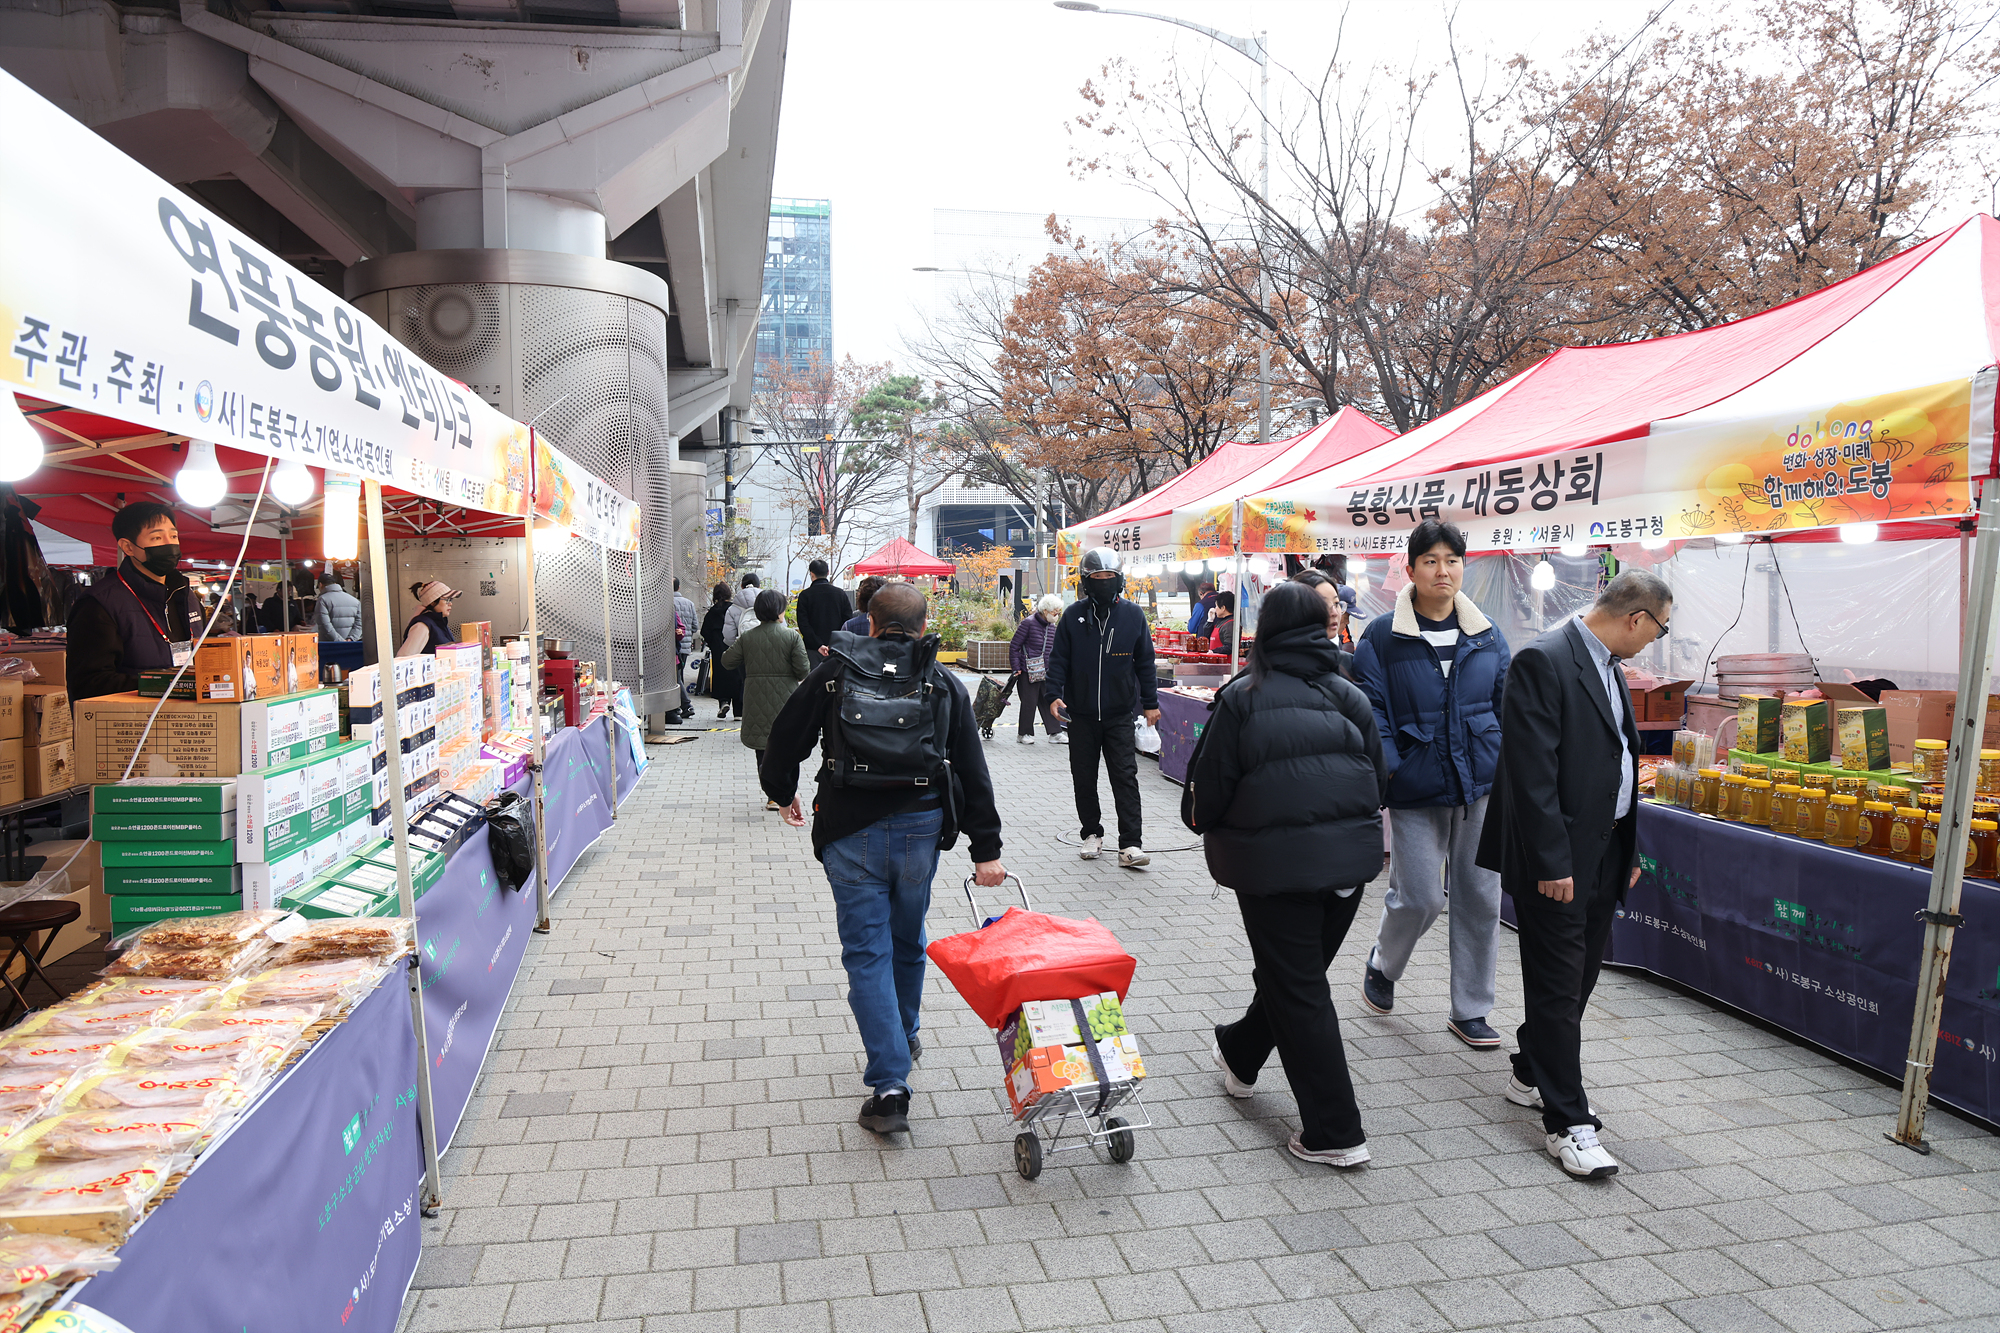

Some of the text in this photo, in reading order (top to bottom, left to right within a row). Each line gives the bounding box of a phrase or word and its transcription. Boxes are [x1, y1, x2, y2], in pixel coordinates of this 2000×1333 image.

[1788, 420, 1873, 448] dobong
[1783, 440, 1871, 472] 변화·성장·미래
[1491, 528, 1513, 546] 후원
[1538, 523, 1574, 543] 서울시
[1606, 515, 1664, 538] 도봉구청
[1645, 915, 1670, 931] 도봉구
[1776, 900, 1804, 918] 함께
[1791, 972, 1821, 992] 도봉구
[1824, 985, 1879, 1015] 소상공인회
[1938, 1029, 1996, 1062] KBIZ 사)
